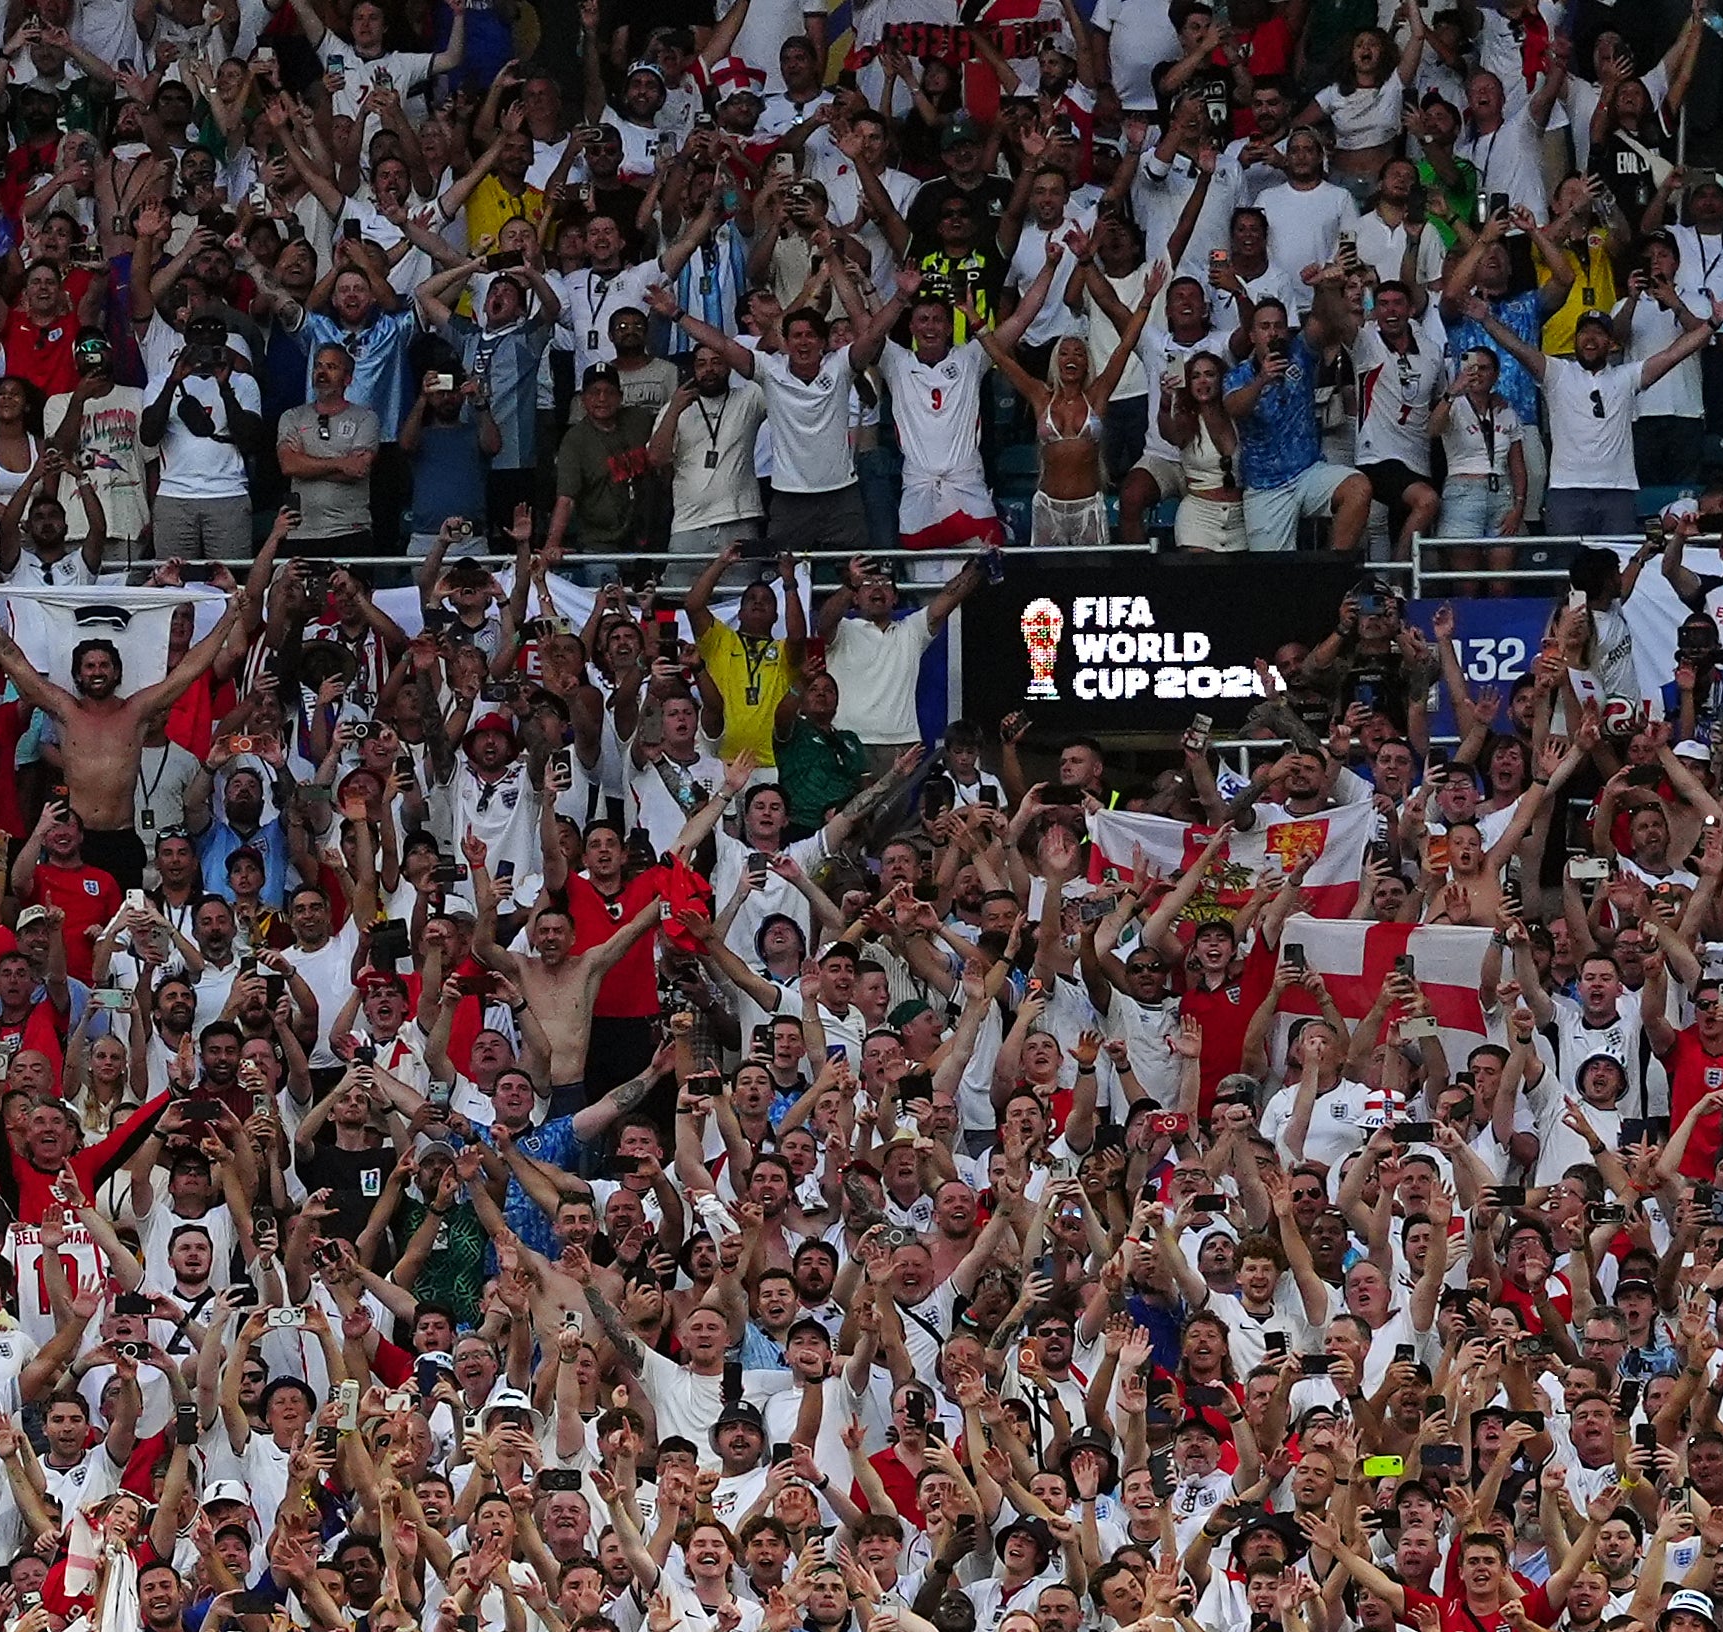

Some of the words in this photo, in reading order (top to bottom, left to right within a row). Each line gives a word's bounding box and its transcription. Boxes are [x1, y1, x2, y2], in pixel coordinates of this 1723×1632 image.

[931, 388, 942, 410] 9
[1073, 597, 1154, 628] FIFA
[1073, 631, 1210, 663] WORLD
[1073, 668, 1150, 700] CUP
